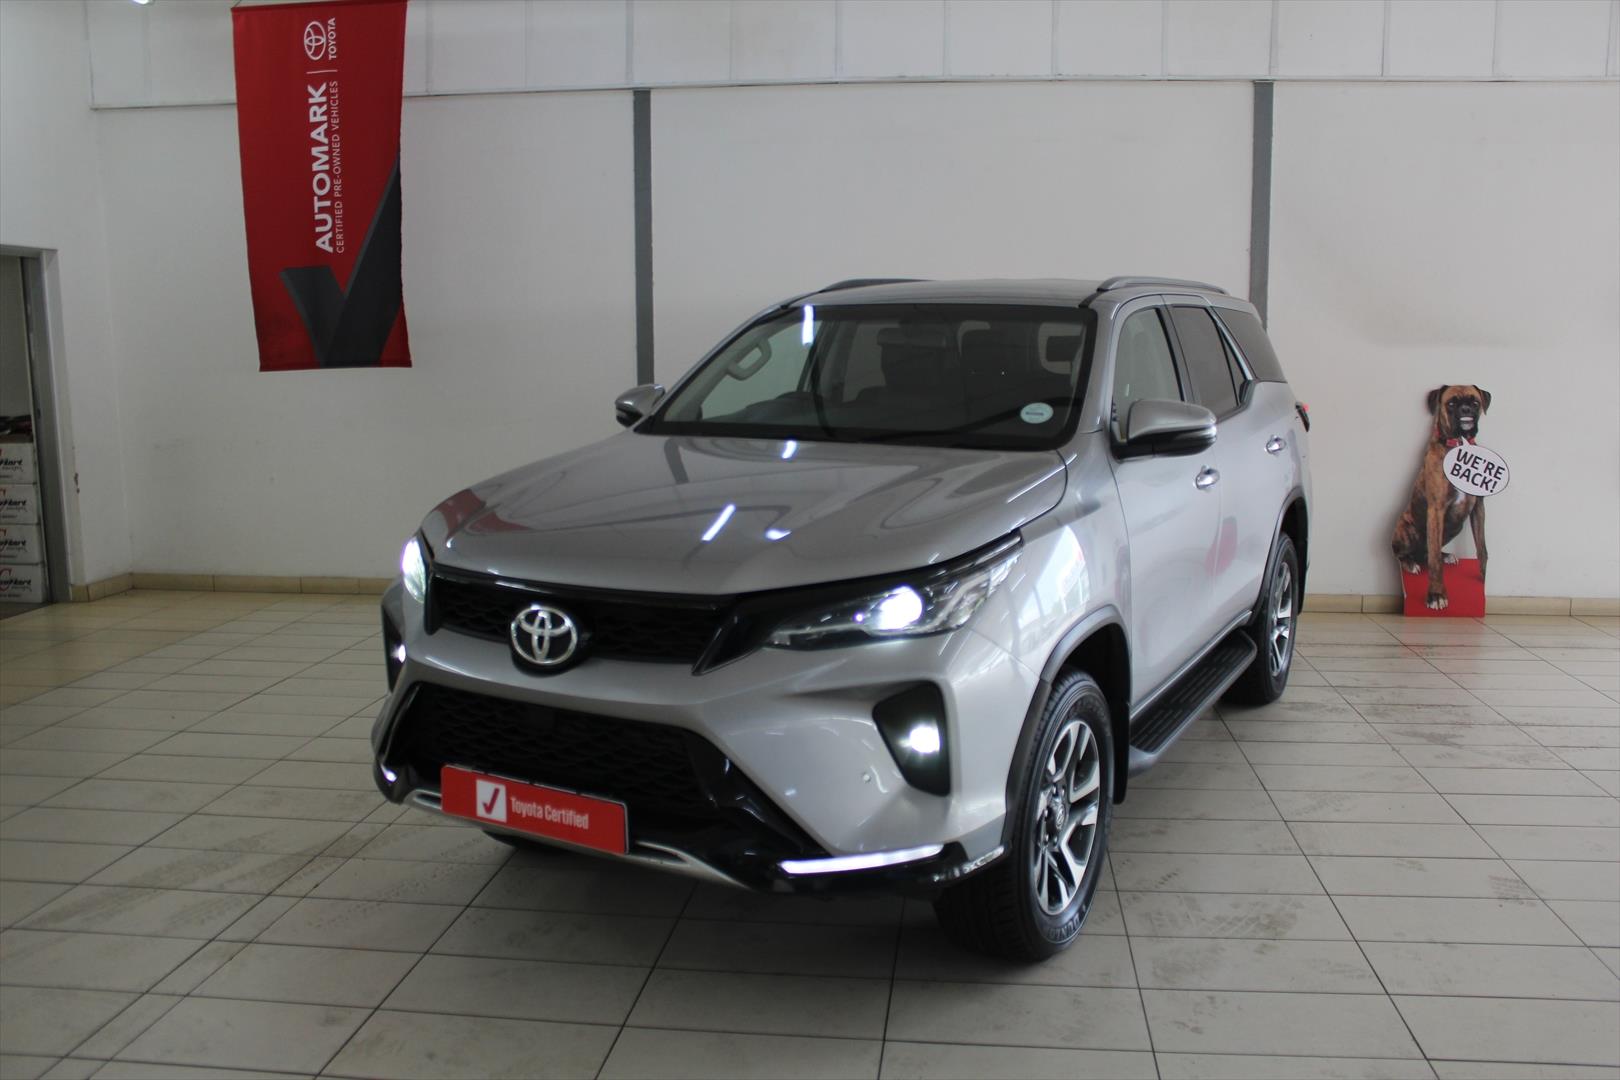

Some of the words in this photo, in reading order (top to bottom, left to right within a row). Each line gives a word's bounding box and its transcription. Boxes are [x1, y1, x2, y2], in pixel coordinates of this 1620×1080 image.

[328, 17, 337, 60] TOYOTA
[329, 80, 340, 131] VEHICLES
[307, 82, 334, 253] AUTOMARK
[331, 133, 342, 198] PRE-OWNED
[334, 201, 345, 254] CERTIFIED
[1450, 462, 1497, 493] BACK!
[1456, 448, 1505, 480] WE'RE
[510, 797, 543, 819] Toyota
[544, 804, 589, 830] Certified
